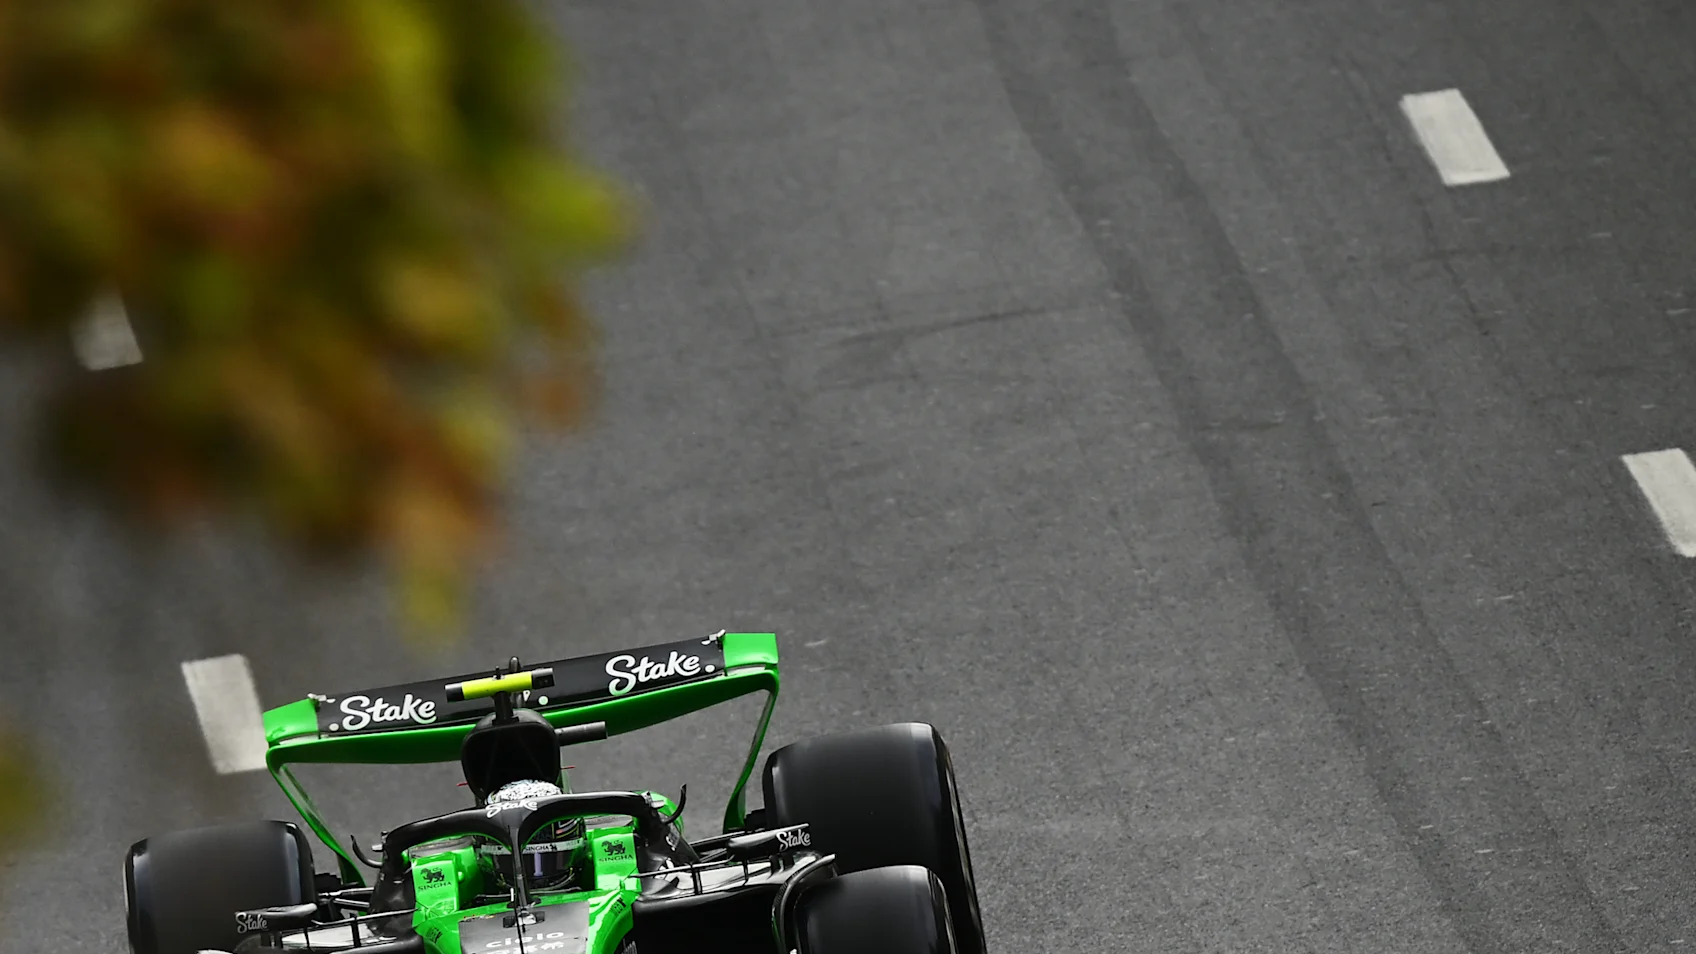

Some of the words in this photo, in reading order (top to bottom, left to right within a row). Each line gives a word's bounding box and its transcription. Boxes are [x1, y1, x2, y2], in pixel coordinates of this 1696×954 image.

[606, 650, 701, 696] Stake
[339, 693, 437, 731] Stake
[485, 800, 538, 818] Stake
[775, 828, 811, 850] Stake
[598, 854, 634, 863] SINGHA
[417, 881, 452, 891] SINGHA
[235, 912, 268, 934] Stake
[486, 932, 564, 948] cielo
